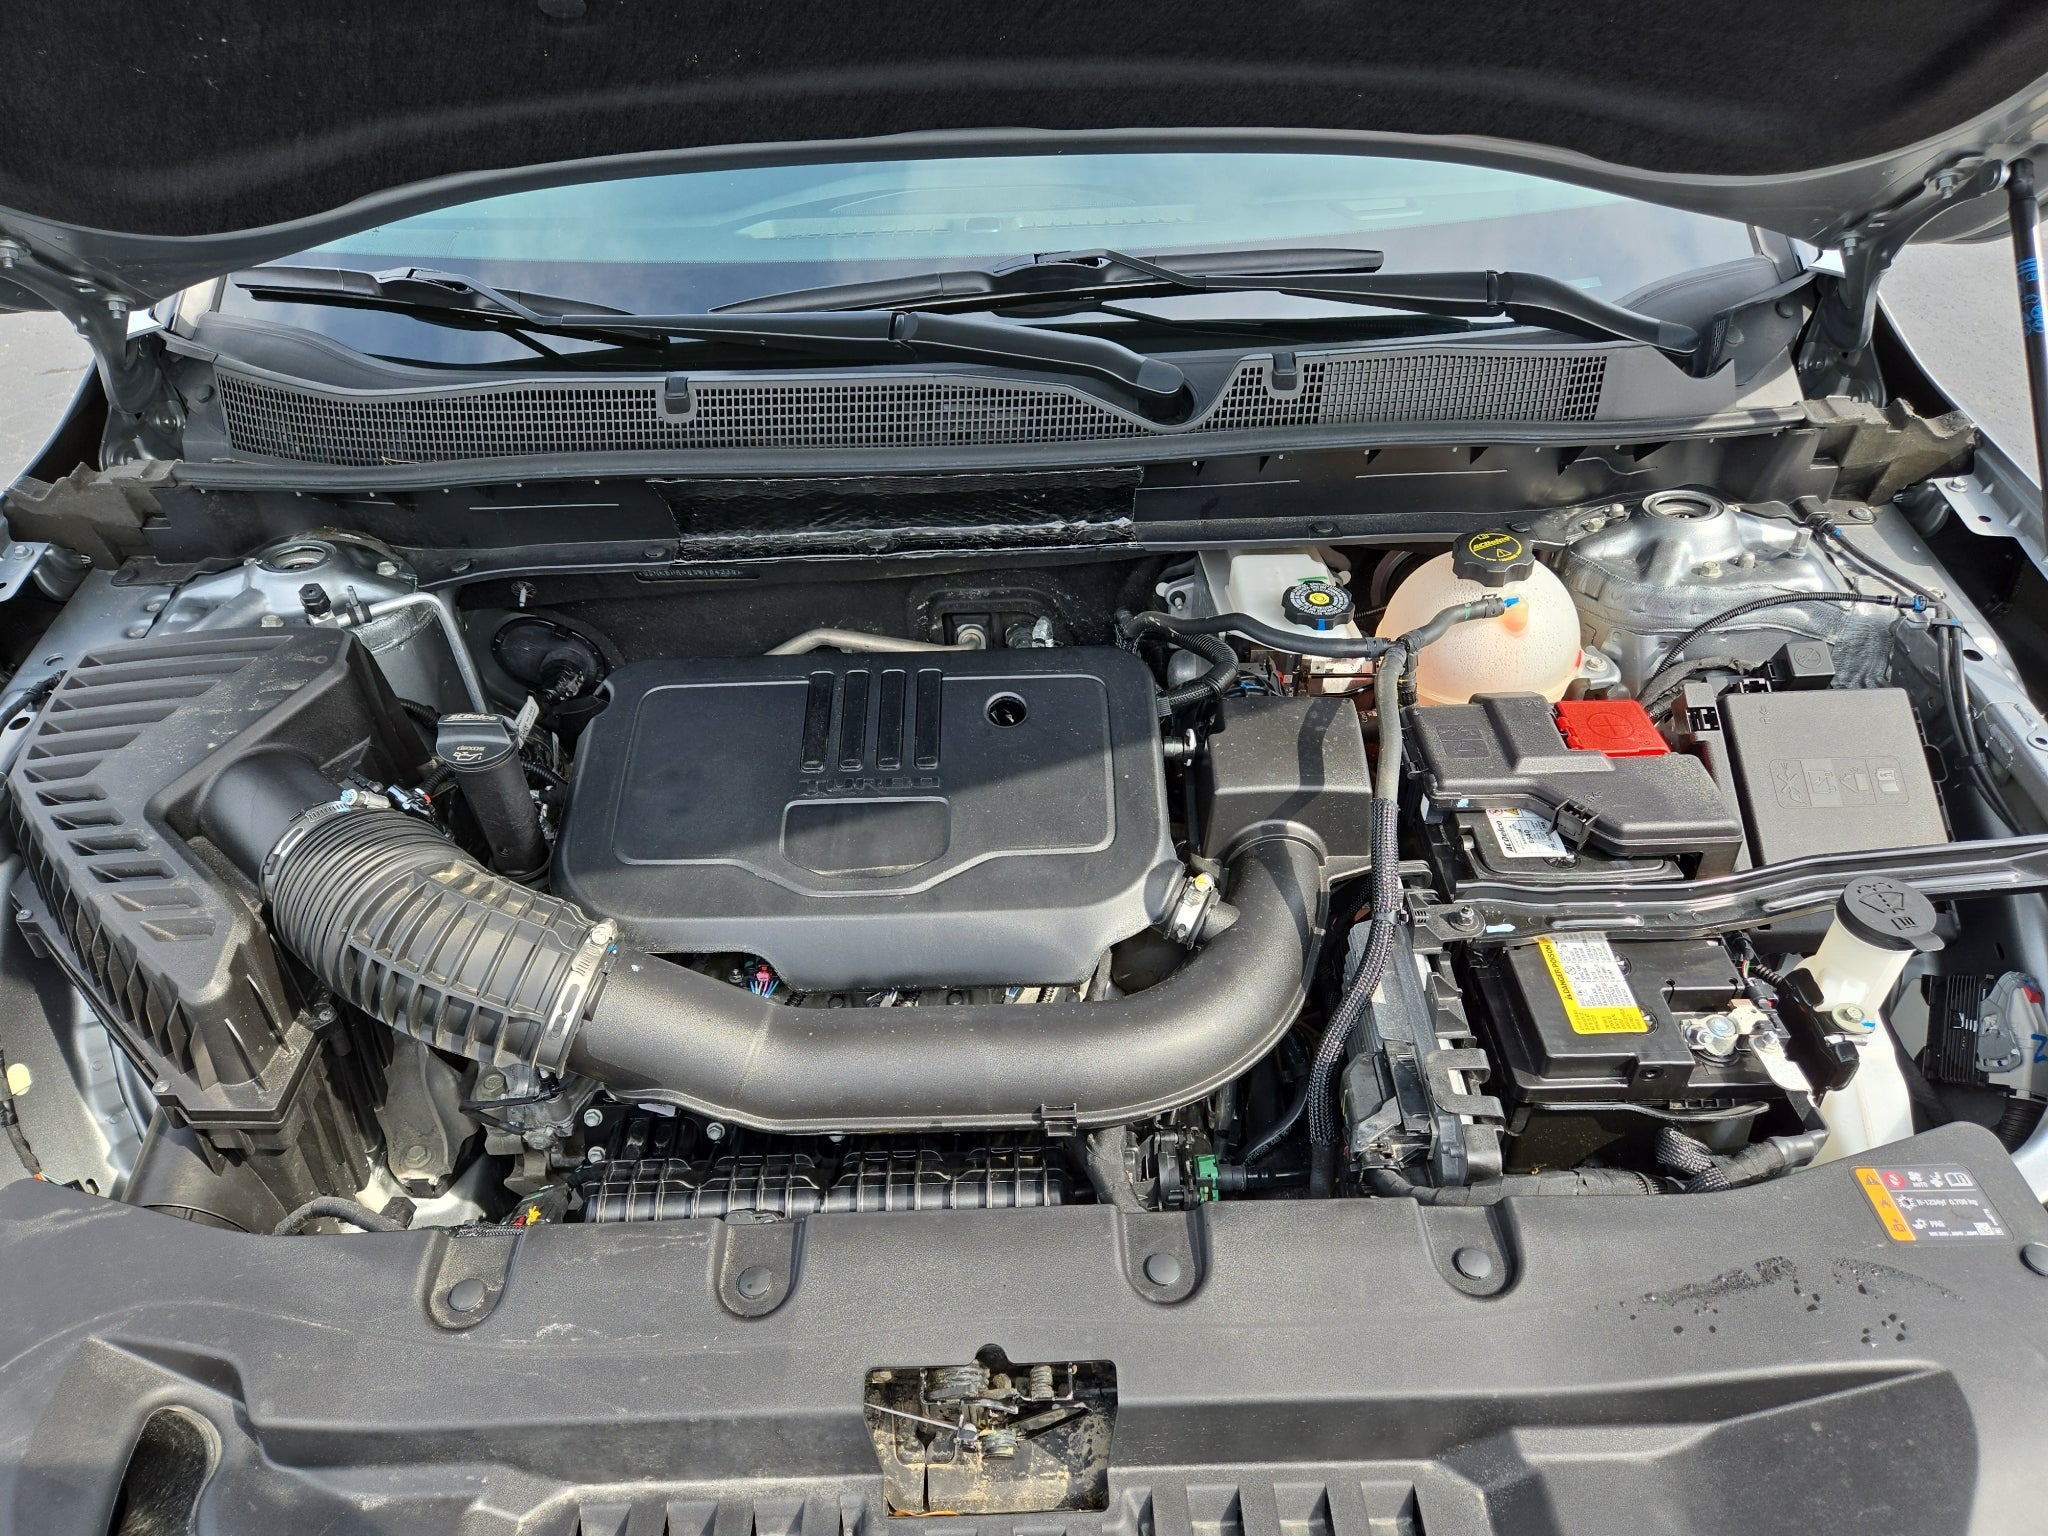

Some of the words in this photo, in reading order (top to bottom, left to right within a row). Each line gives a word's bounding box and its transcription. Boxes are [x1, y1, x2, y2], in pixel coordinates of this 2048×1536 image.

[447, 713, 498, 721] ACDelco
[799, 777, 940, 793] TURBO
[1496, 820, 1515, 852] ACDelco
